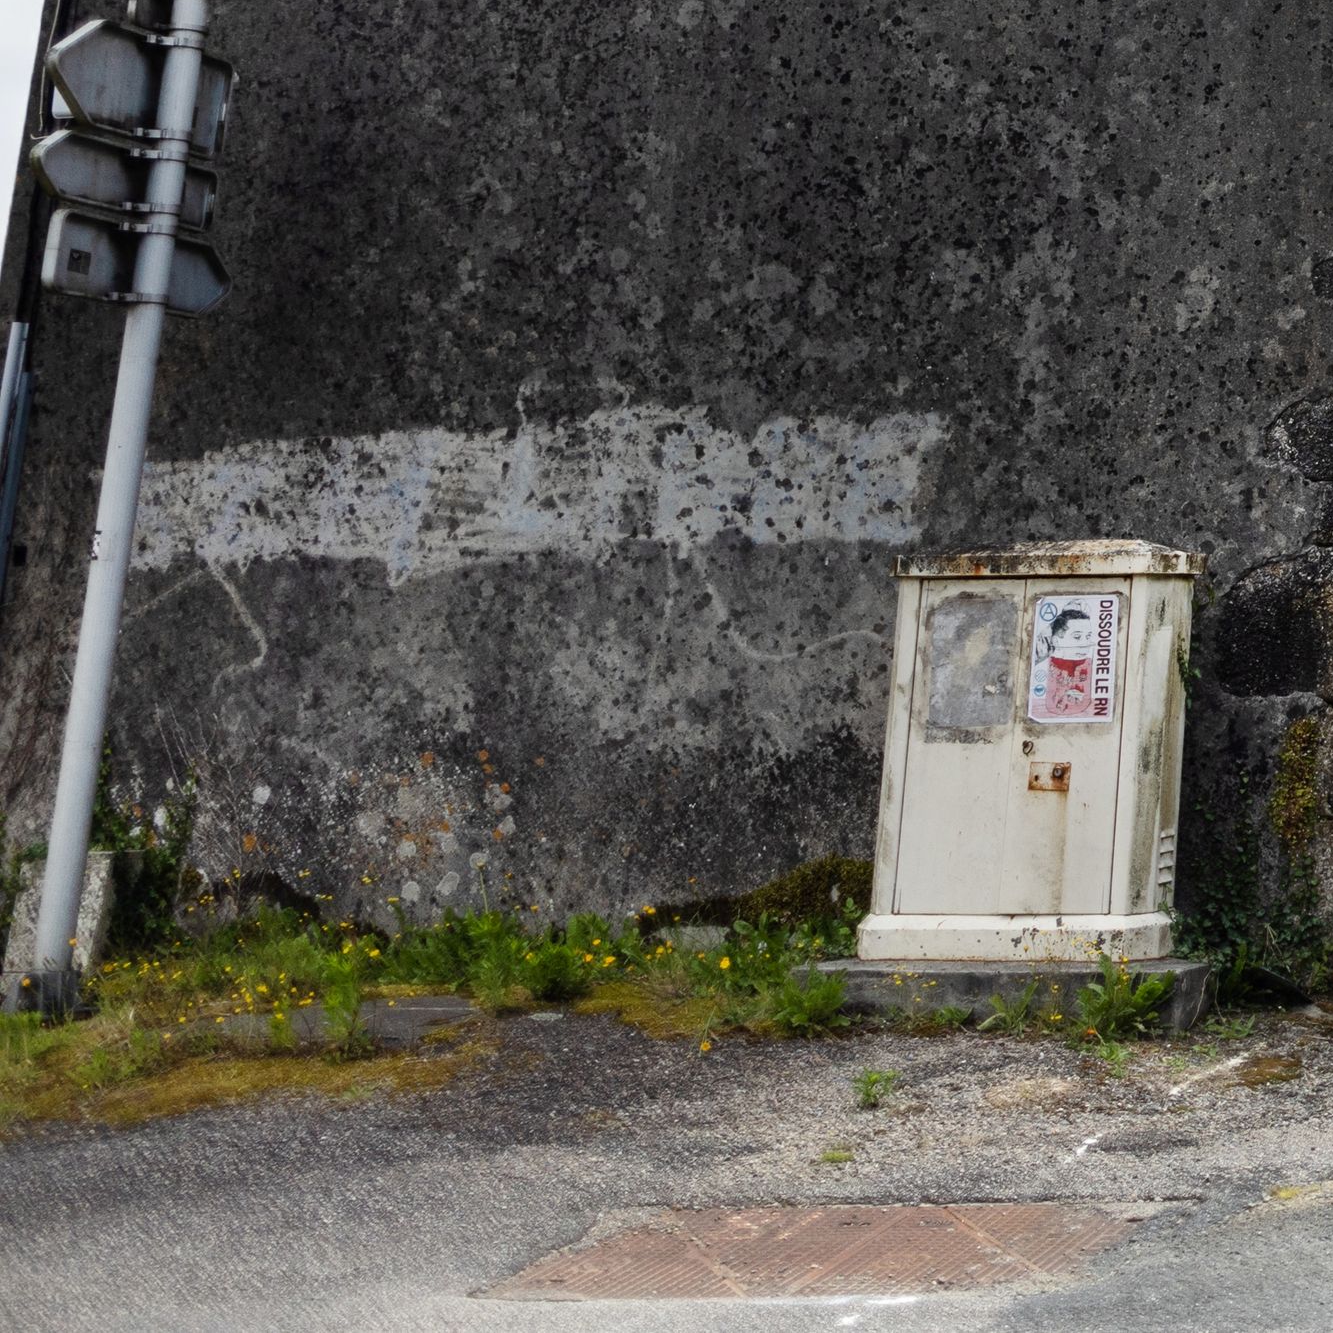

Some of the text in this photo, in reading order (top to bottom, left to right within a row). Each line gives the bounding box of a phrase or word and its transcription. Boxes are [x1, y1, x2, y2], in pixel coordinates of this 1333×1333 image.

[1093, 600, 1114, 716] DISSOUDRE LE RN
